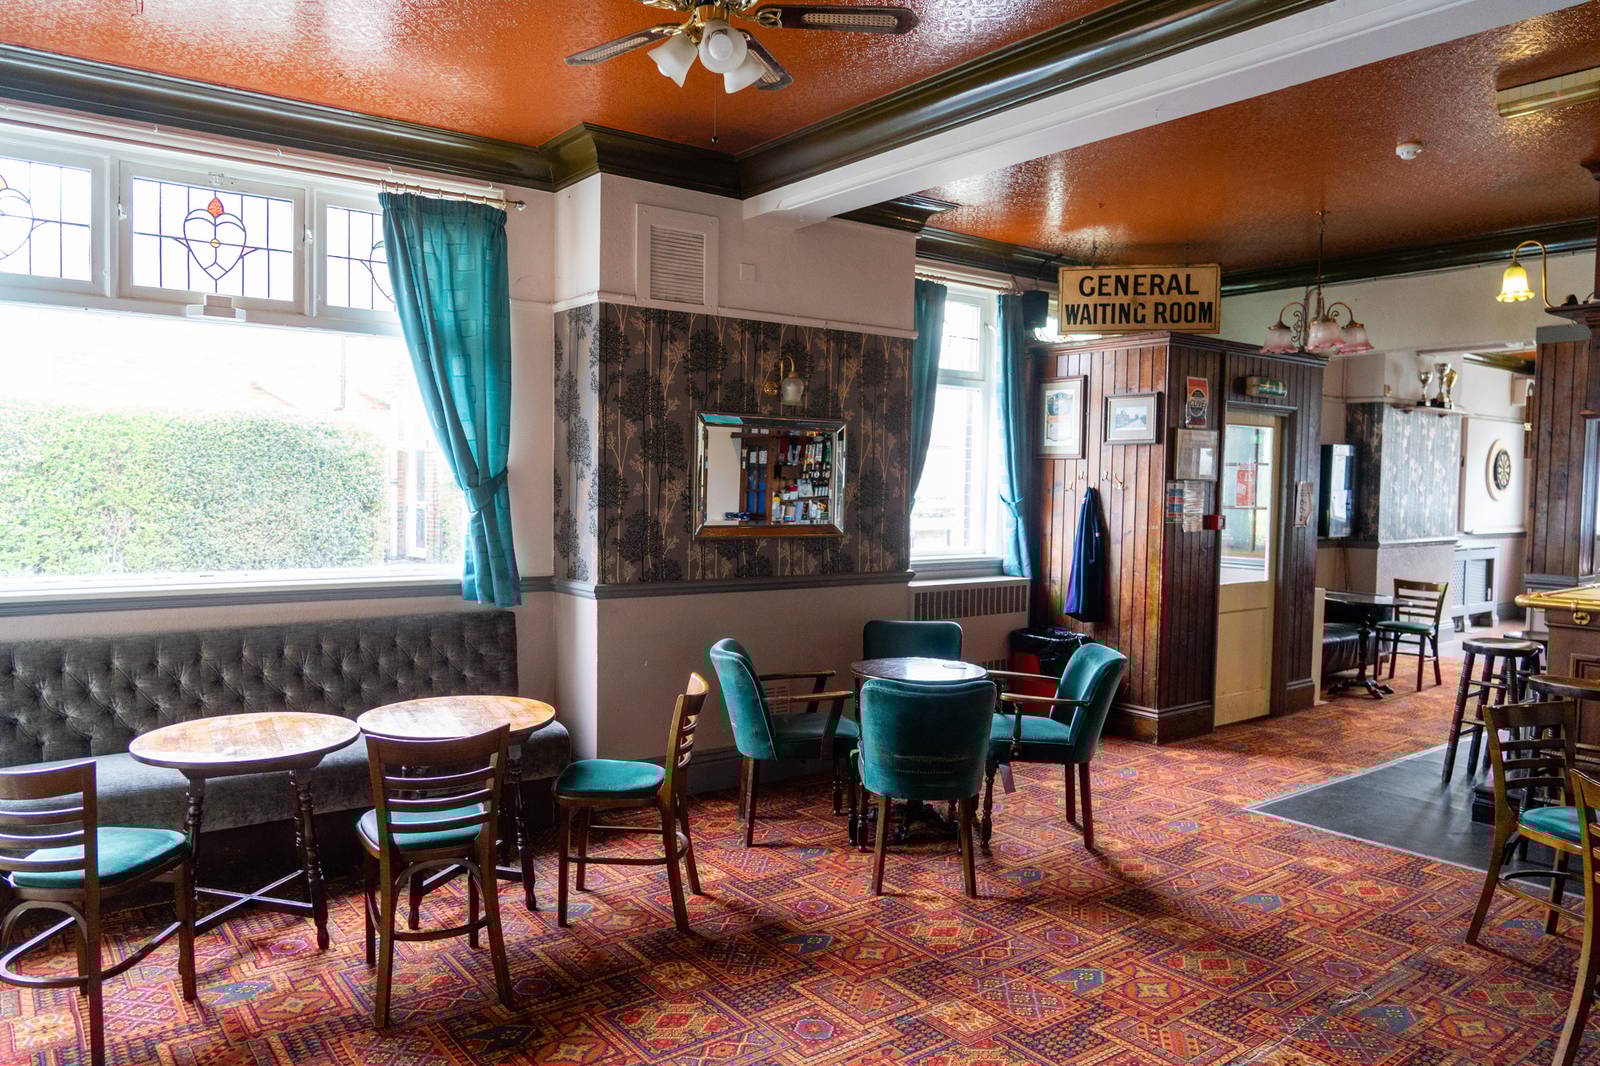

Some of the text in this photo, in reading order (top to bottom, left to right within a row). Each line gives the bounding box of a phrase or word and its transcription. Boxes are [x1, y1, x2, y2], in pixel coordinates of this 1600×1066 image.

[1079, 274, 1199, 297] GENERAL
[1065, 301, 1213, 325] WAITING ROOM
